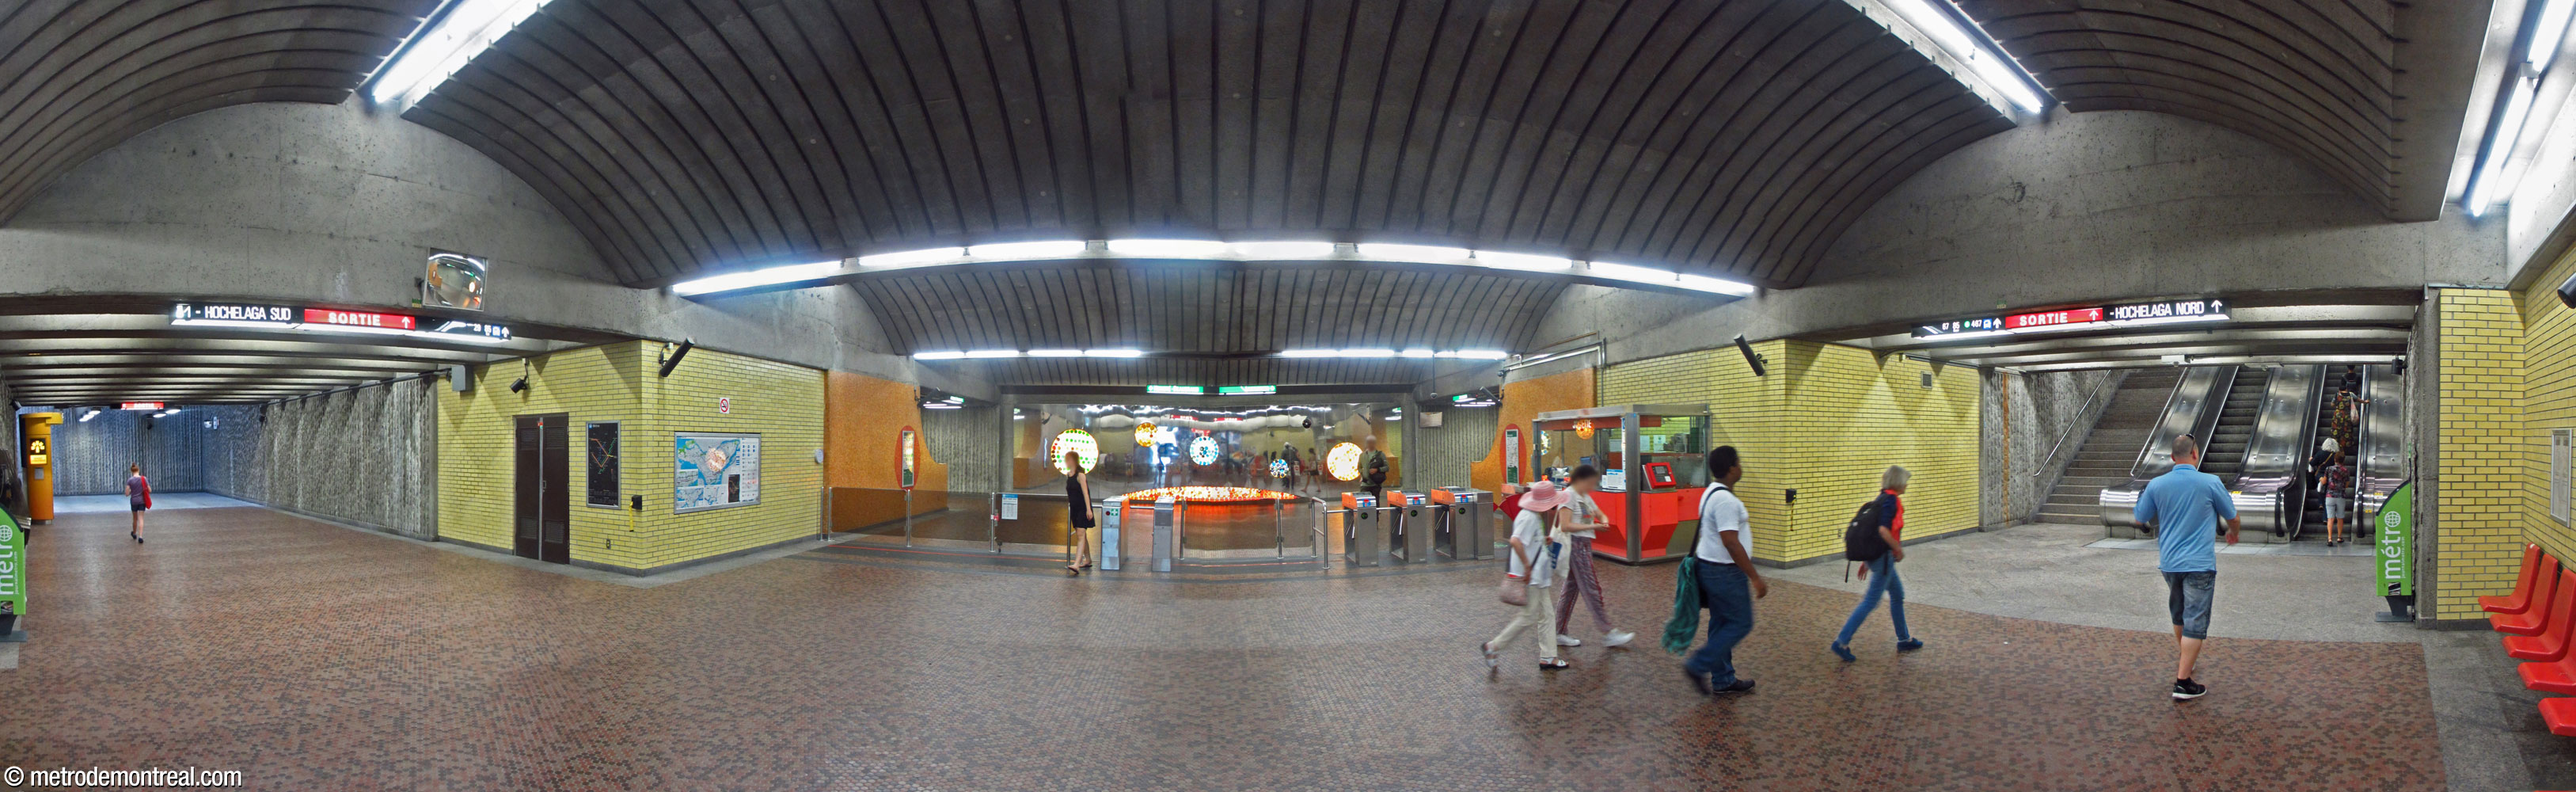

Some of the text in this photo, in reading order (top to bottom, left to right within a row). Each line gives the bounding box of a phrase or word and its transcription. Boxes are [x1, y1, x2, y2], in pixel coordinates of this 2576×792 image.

[204, 305, 267, 320] HOCHELAGA
[270, 307, 291, 321] SUD
[2175, 301, 2205, 315] NORD
[328, 312, 381, 326] SORTIE
[2019, 312, 2068, 326] SORTIE
